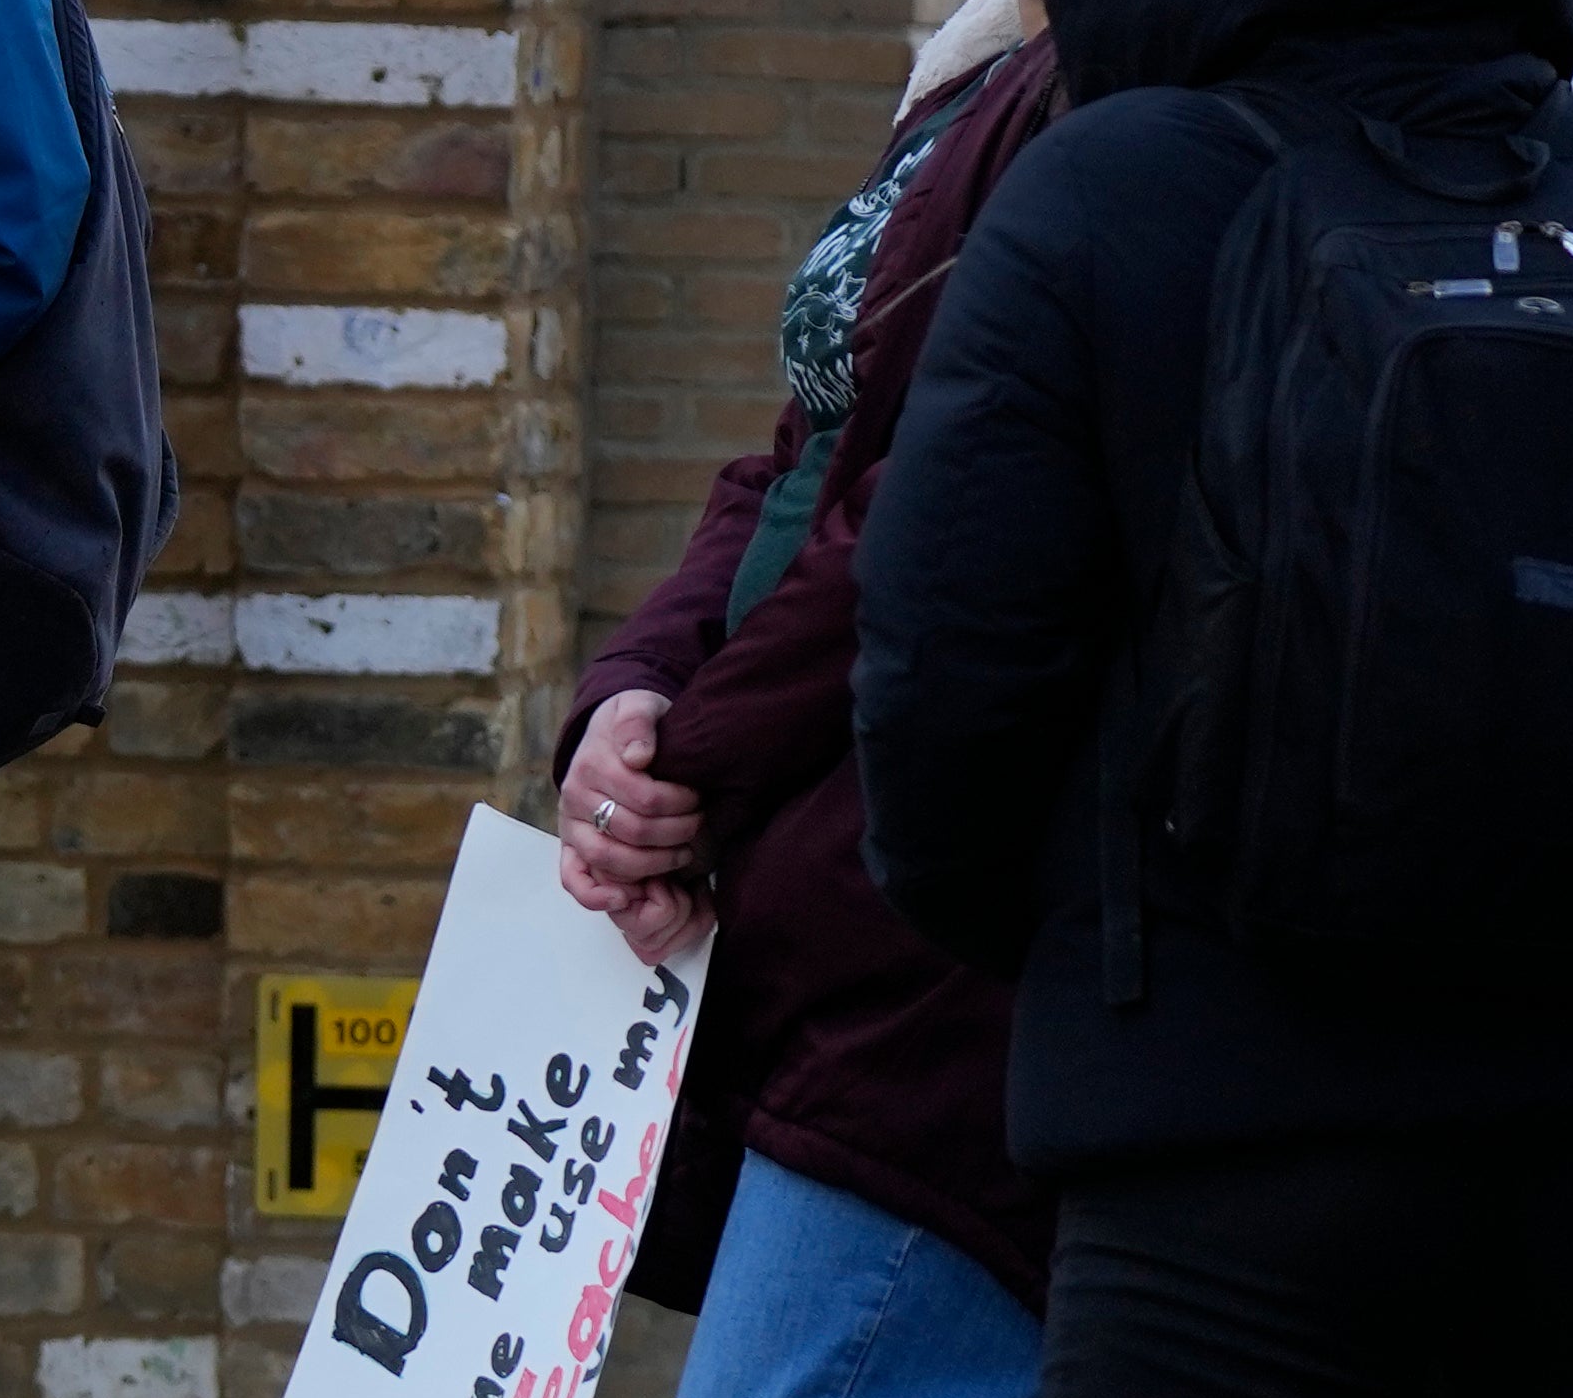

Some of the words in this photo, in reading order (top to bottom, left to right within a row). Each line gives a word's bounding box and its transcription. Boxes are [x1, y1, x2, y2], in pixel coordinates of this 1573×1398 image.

[333, 1017, 397, 1046] 100
[539, 1114, 616, 1255] use
[612, 962, 691, 1092] my
[332, 1065, 507, 1378] Don't
[468, 1052, 591, 1302] make
